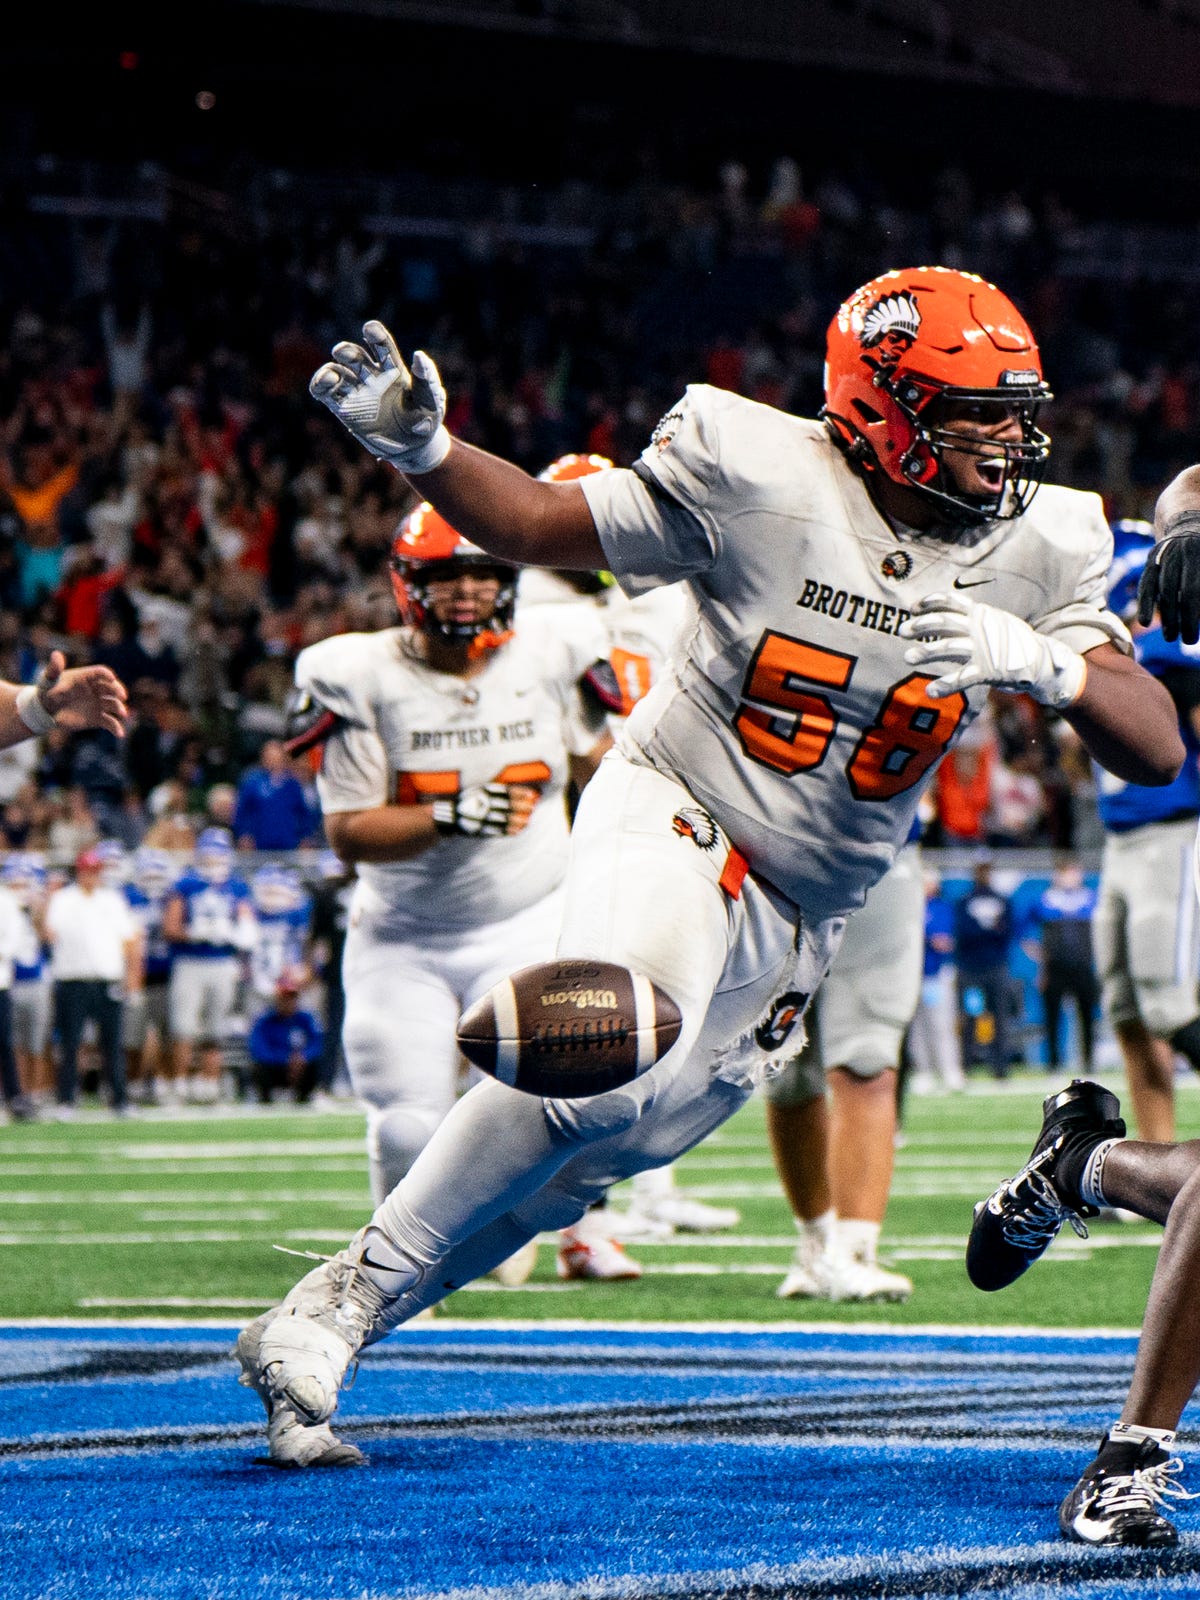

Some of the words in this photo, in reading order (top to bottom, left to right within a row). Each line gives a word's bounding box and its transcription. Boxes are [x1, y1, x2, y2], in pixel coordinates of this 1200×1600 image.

[731, 627, 969, 802] 58
[411, 726, 490, 751] BROTHER
[498, 720, 535, 742] RICE
[541, 990, 618, 1009] Wilson
